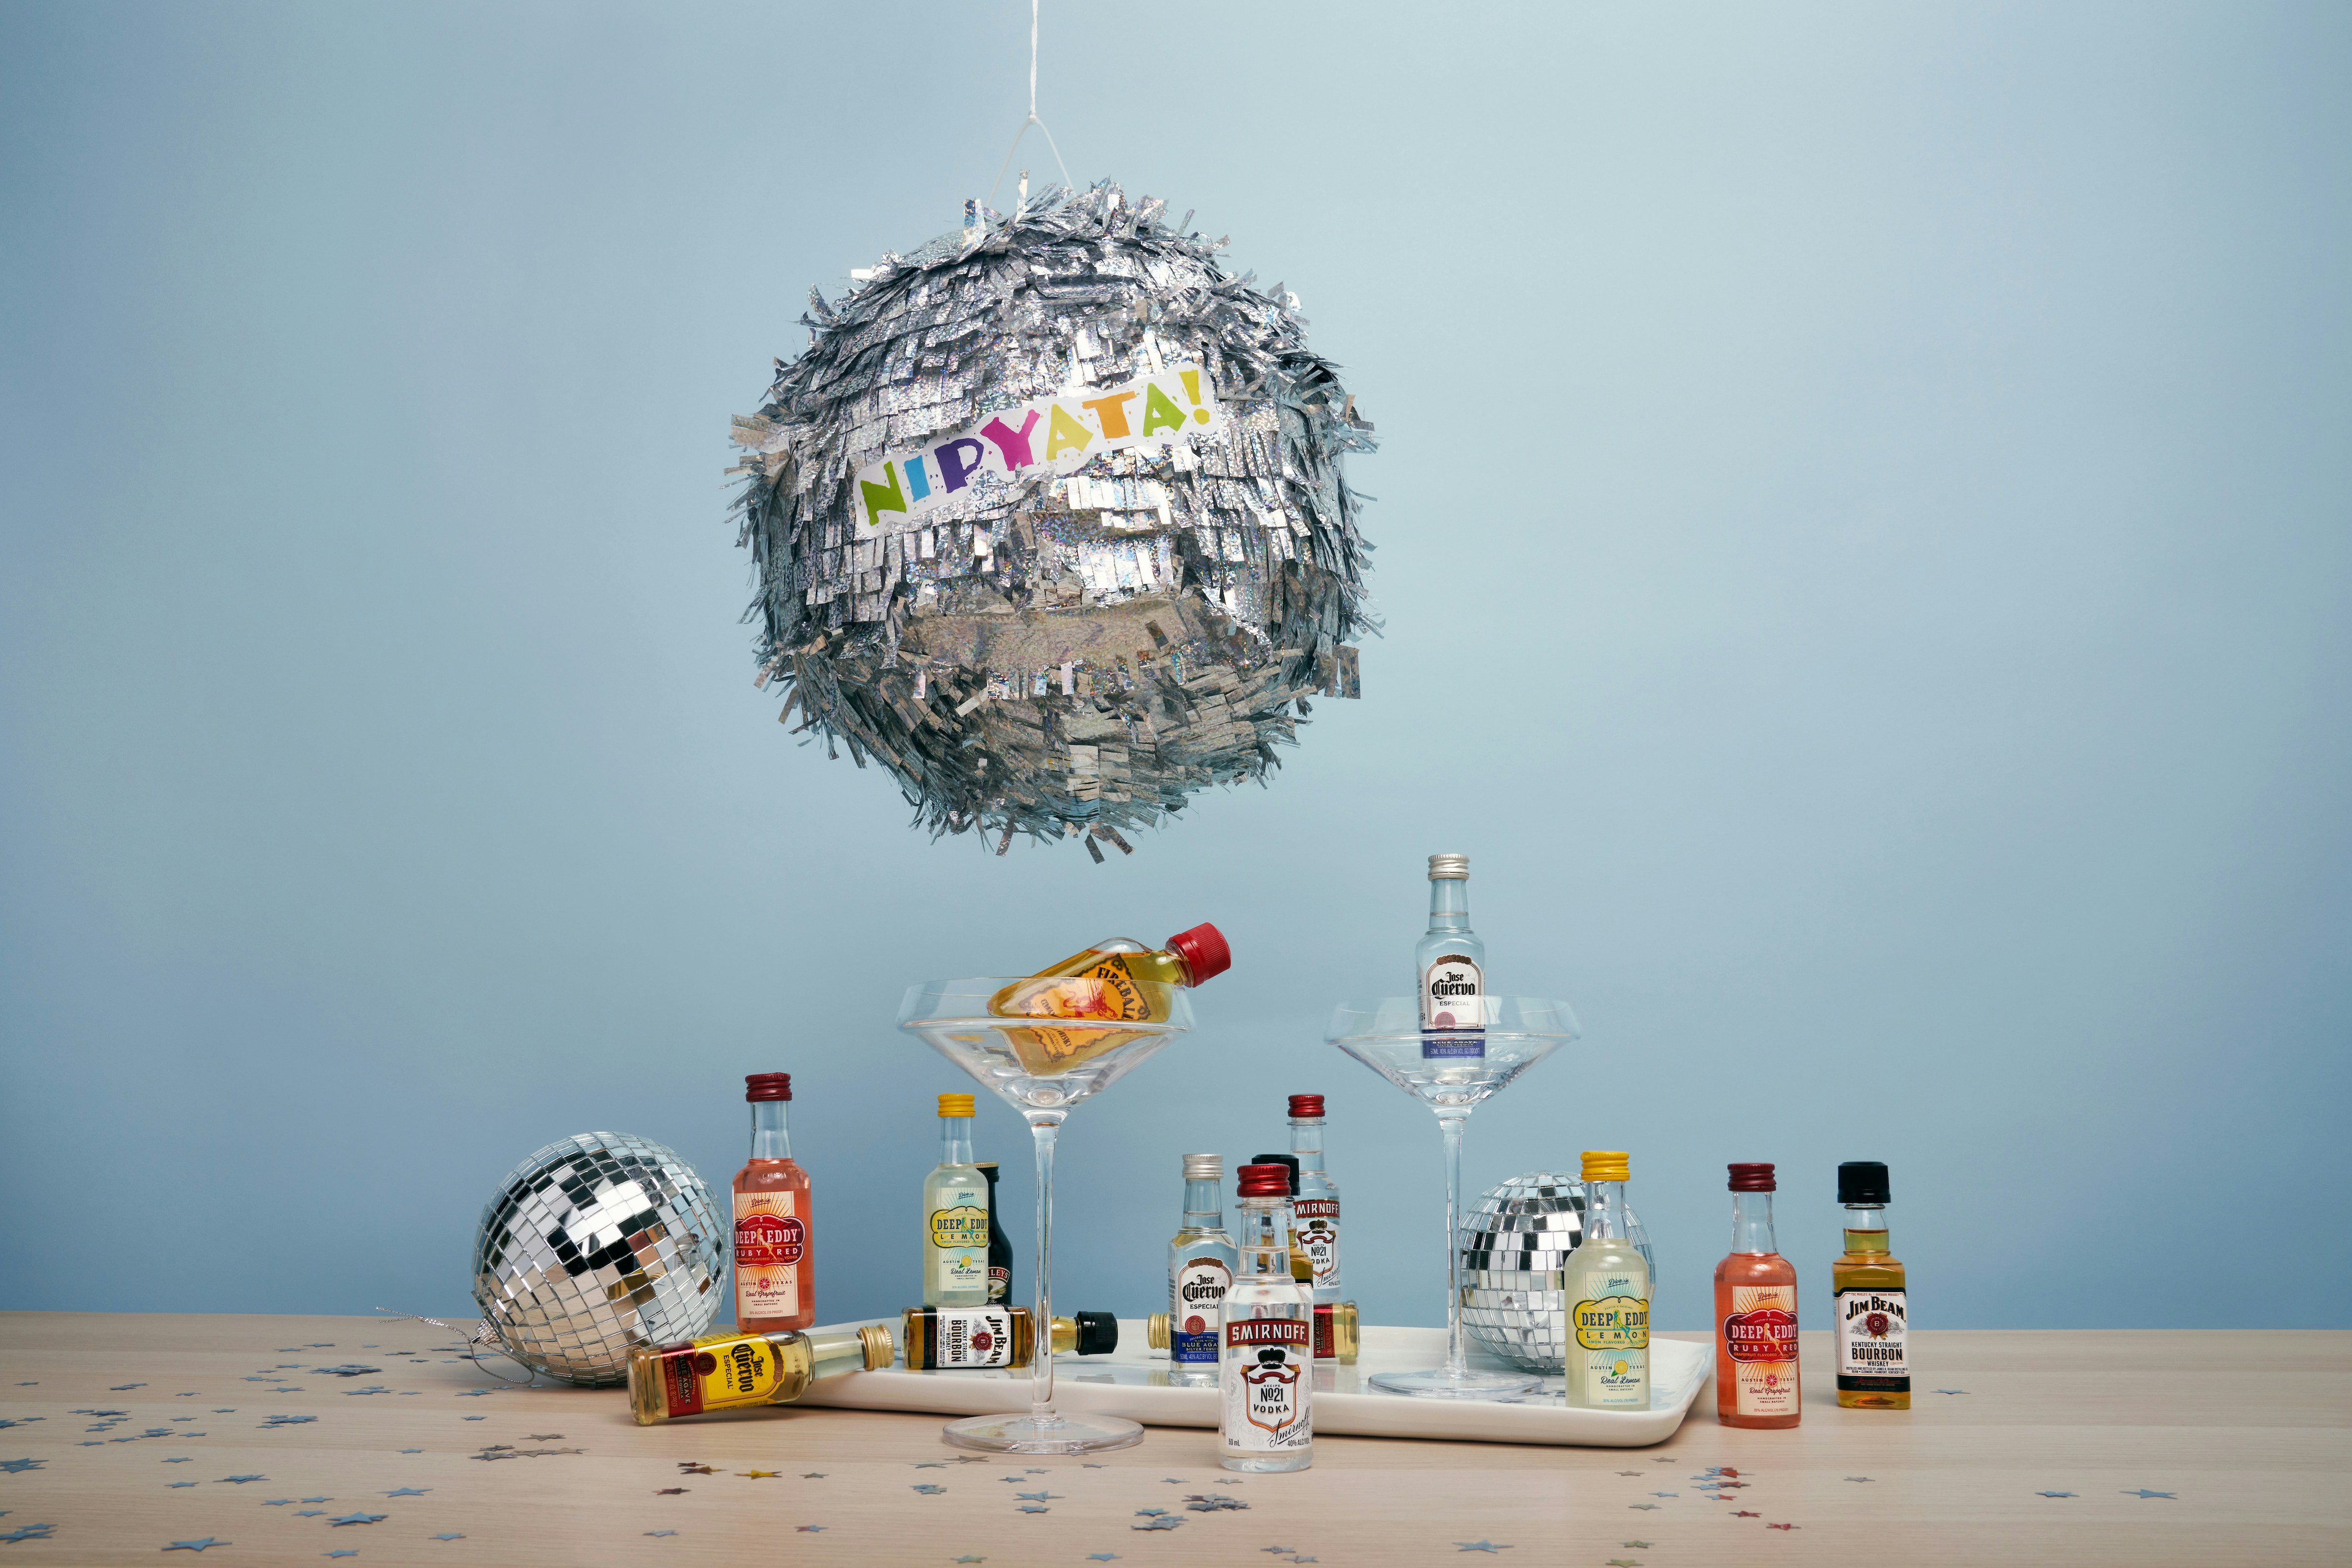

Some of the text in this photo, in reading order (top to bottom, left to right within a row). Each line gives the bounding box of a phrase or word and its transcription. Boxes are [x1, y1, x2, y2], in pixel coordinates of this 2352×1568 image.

[860, 369, 1210, 526] NIPYATA!
[1446, 972, 1464, 983] Jose
[1097, 967, 1135, 1019] FIREBALL
[1431, 979, 1475, 999] Cuervo
[937, 1219, 987, 1229] DEEP EDDY
[735, 1229, 798, 1244] DEEP EDDY
[988, 1269, 1008, 1279] LEYS
[1197, 1274, 1214, 1286] Jose
[1182, 1281, 1225, 1302] Cuervo
[1846, 1296, 1904, 1321] JIM BEAM
[985, 1316, 1003, 1335] JIM
[1582, 1311, 1647, 1326] DEEP EDDY
[951, 1320, 962, 1362] BOURBON
[1232, 1324, 1305, 1342] SMIRNOFF
[1732, 1324, 1796, 1339] DEEP EDDY
[985, 1337, 1007, 1364] BEAM
[1852, 1348, 1903, 1361] BOURBON
[724, 1355, 733, 1389] ESPECIAL
[731, 1344, 755, 1393] Cuervo
[752, 1356, 764, 1377] Jose
[1765, 1387, 1791, 1396] Grapefruit
[1253, 1404, 1290, 1414] VODKA
[1267, 1406, 1311, 1448] Smirnoff
